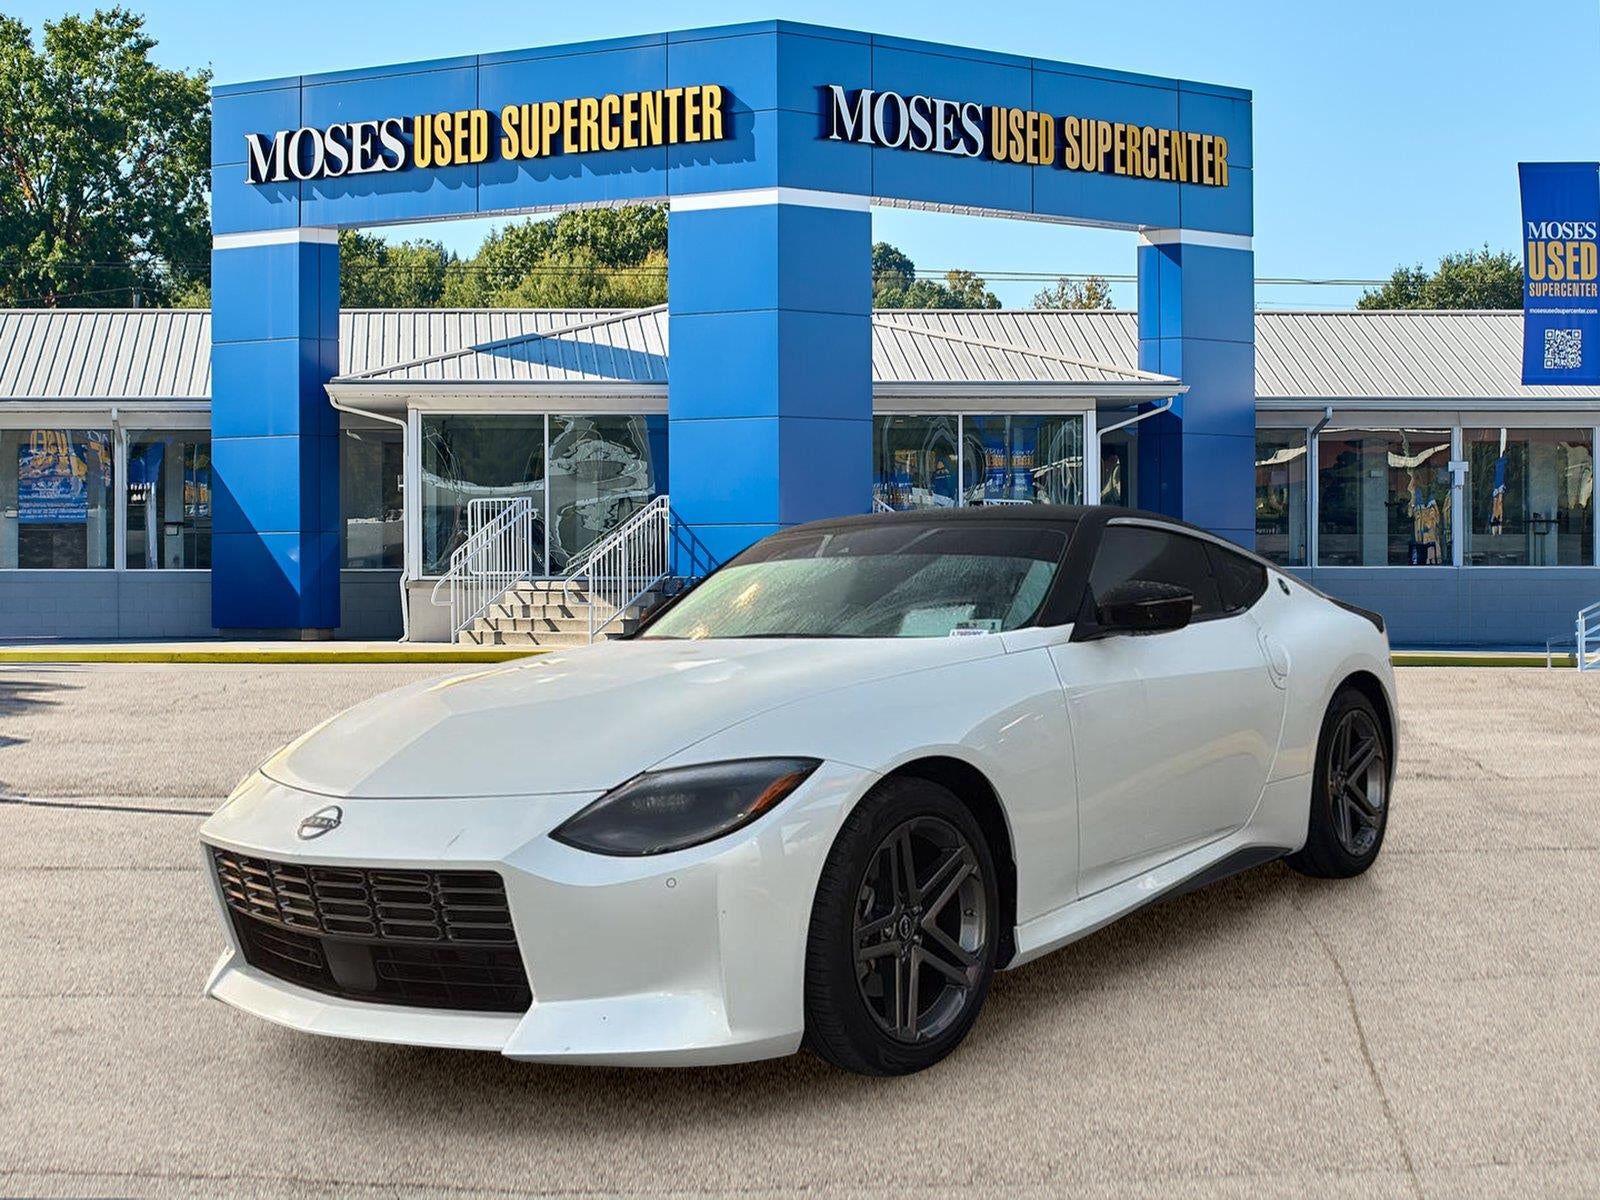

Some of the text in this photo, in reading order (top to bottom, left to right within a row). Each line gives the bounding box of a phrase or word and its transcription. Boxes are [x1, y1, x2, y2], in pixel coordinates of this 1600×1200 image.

[245, 85, 723, 185] MOSES USED SUPERCENTER
[829, 84, 1229, 187] MOSES USED SUPERCENTER
[1528, 222, 1597, 239] MOSES
[1529, 242, 1598, 280] USED
[1530, 283, 1598, 297] SUPERCENTER
